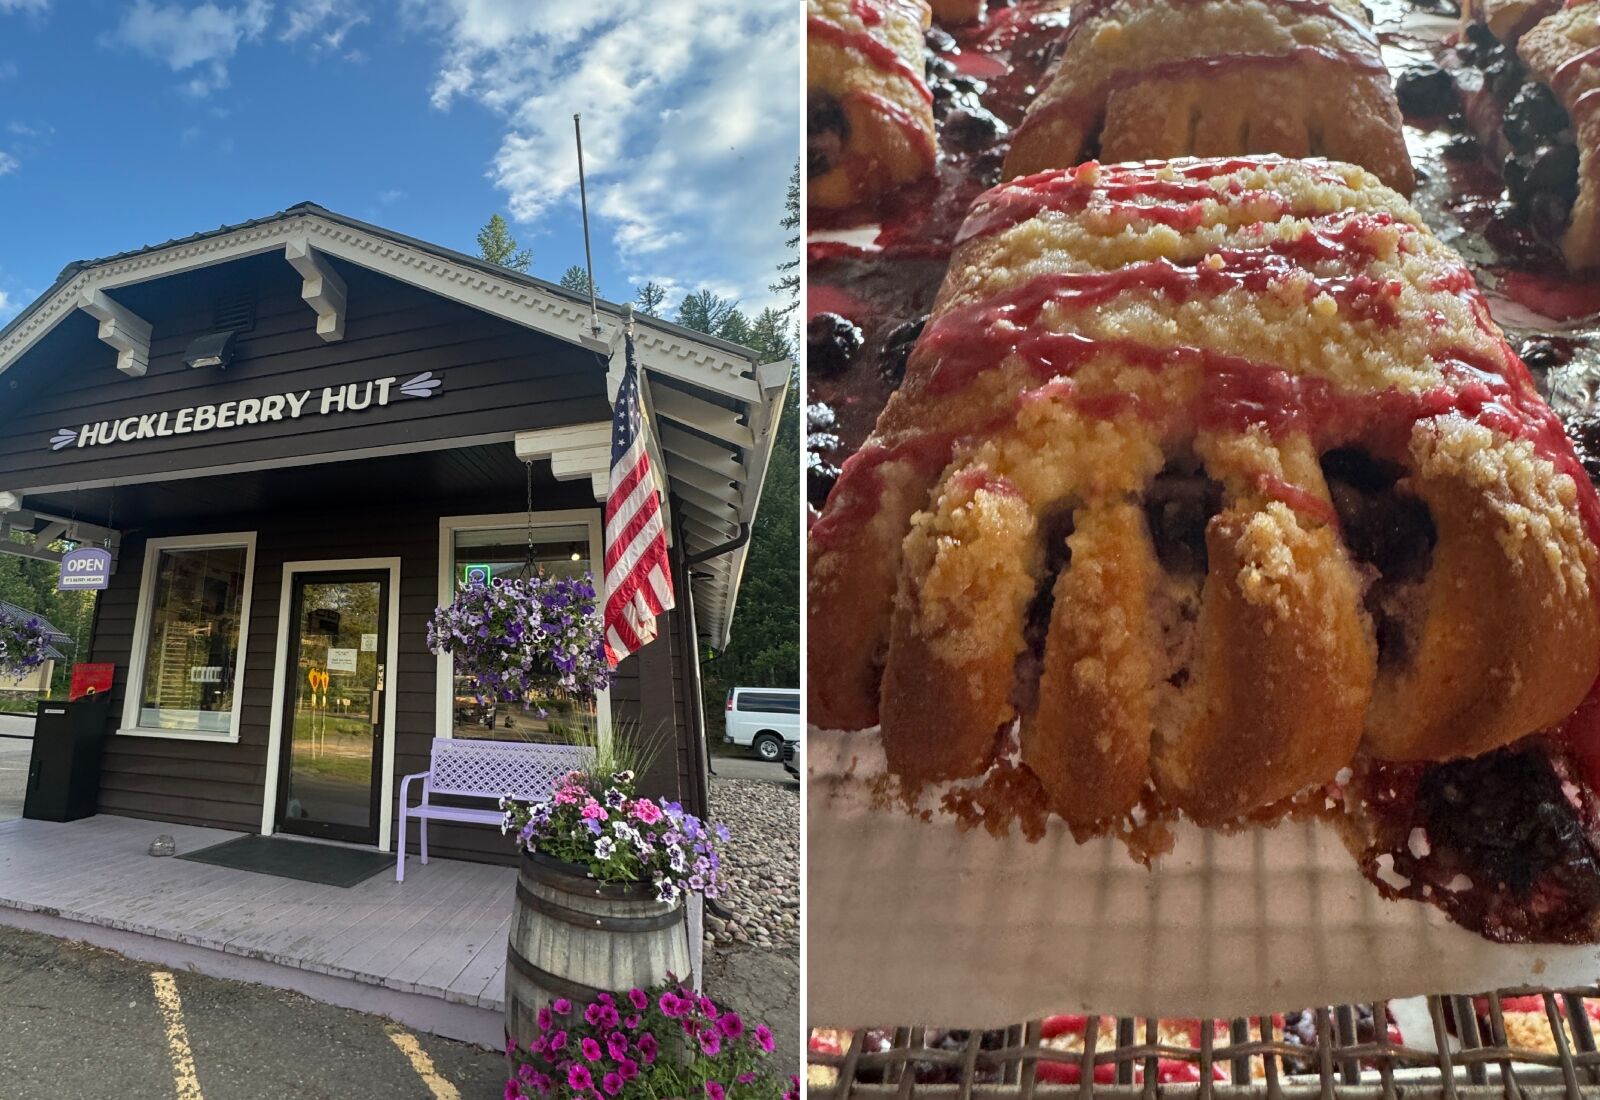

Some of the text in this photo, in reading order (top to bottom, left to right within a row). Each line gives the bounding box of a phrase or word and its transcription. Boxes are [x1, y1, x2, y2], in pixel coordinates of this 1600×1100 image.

[77, 376, 397, 448] HUCKLEBERRY HUT
[67, 559, 104, 571] OPEN
